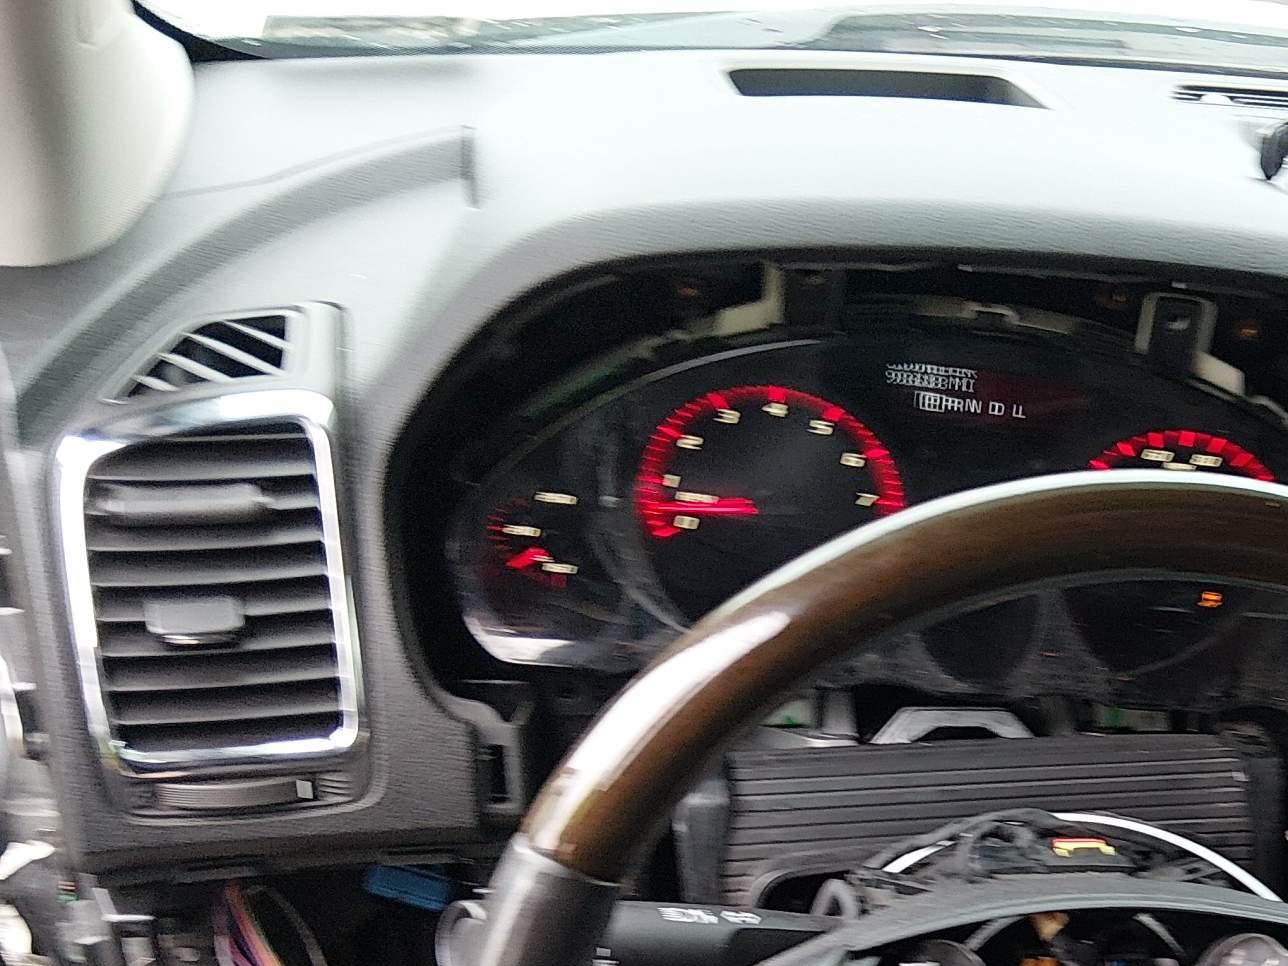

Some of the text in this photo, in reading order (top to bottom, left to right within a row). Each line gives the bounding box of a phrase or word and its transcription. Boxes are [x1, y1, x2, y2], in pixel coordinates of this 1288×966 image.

[713, 408, 742, 424] 3
[807, 419, 835, 436] 5
[676, 434, 704, 450] 2
